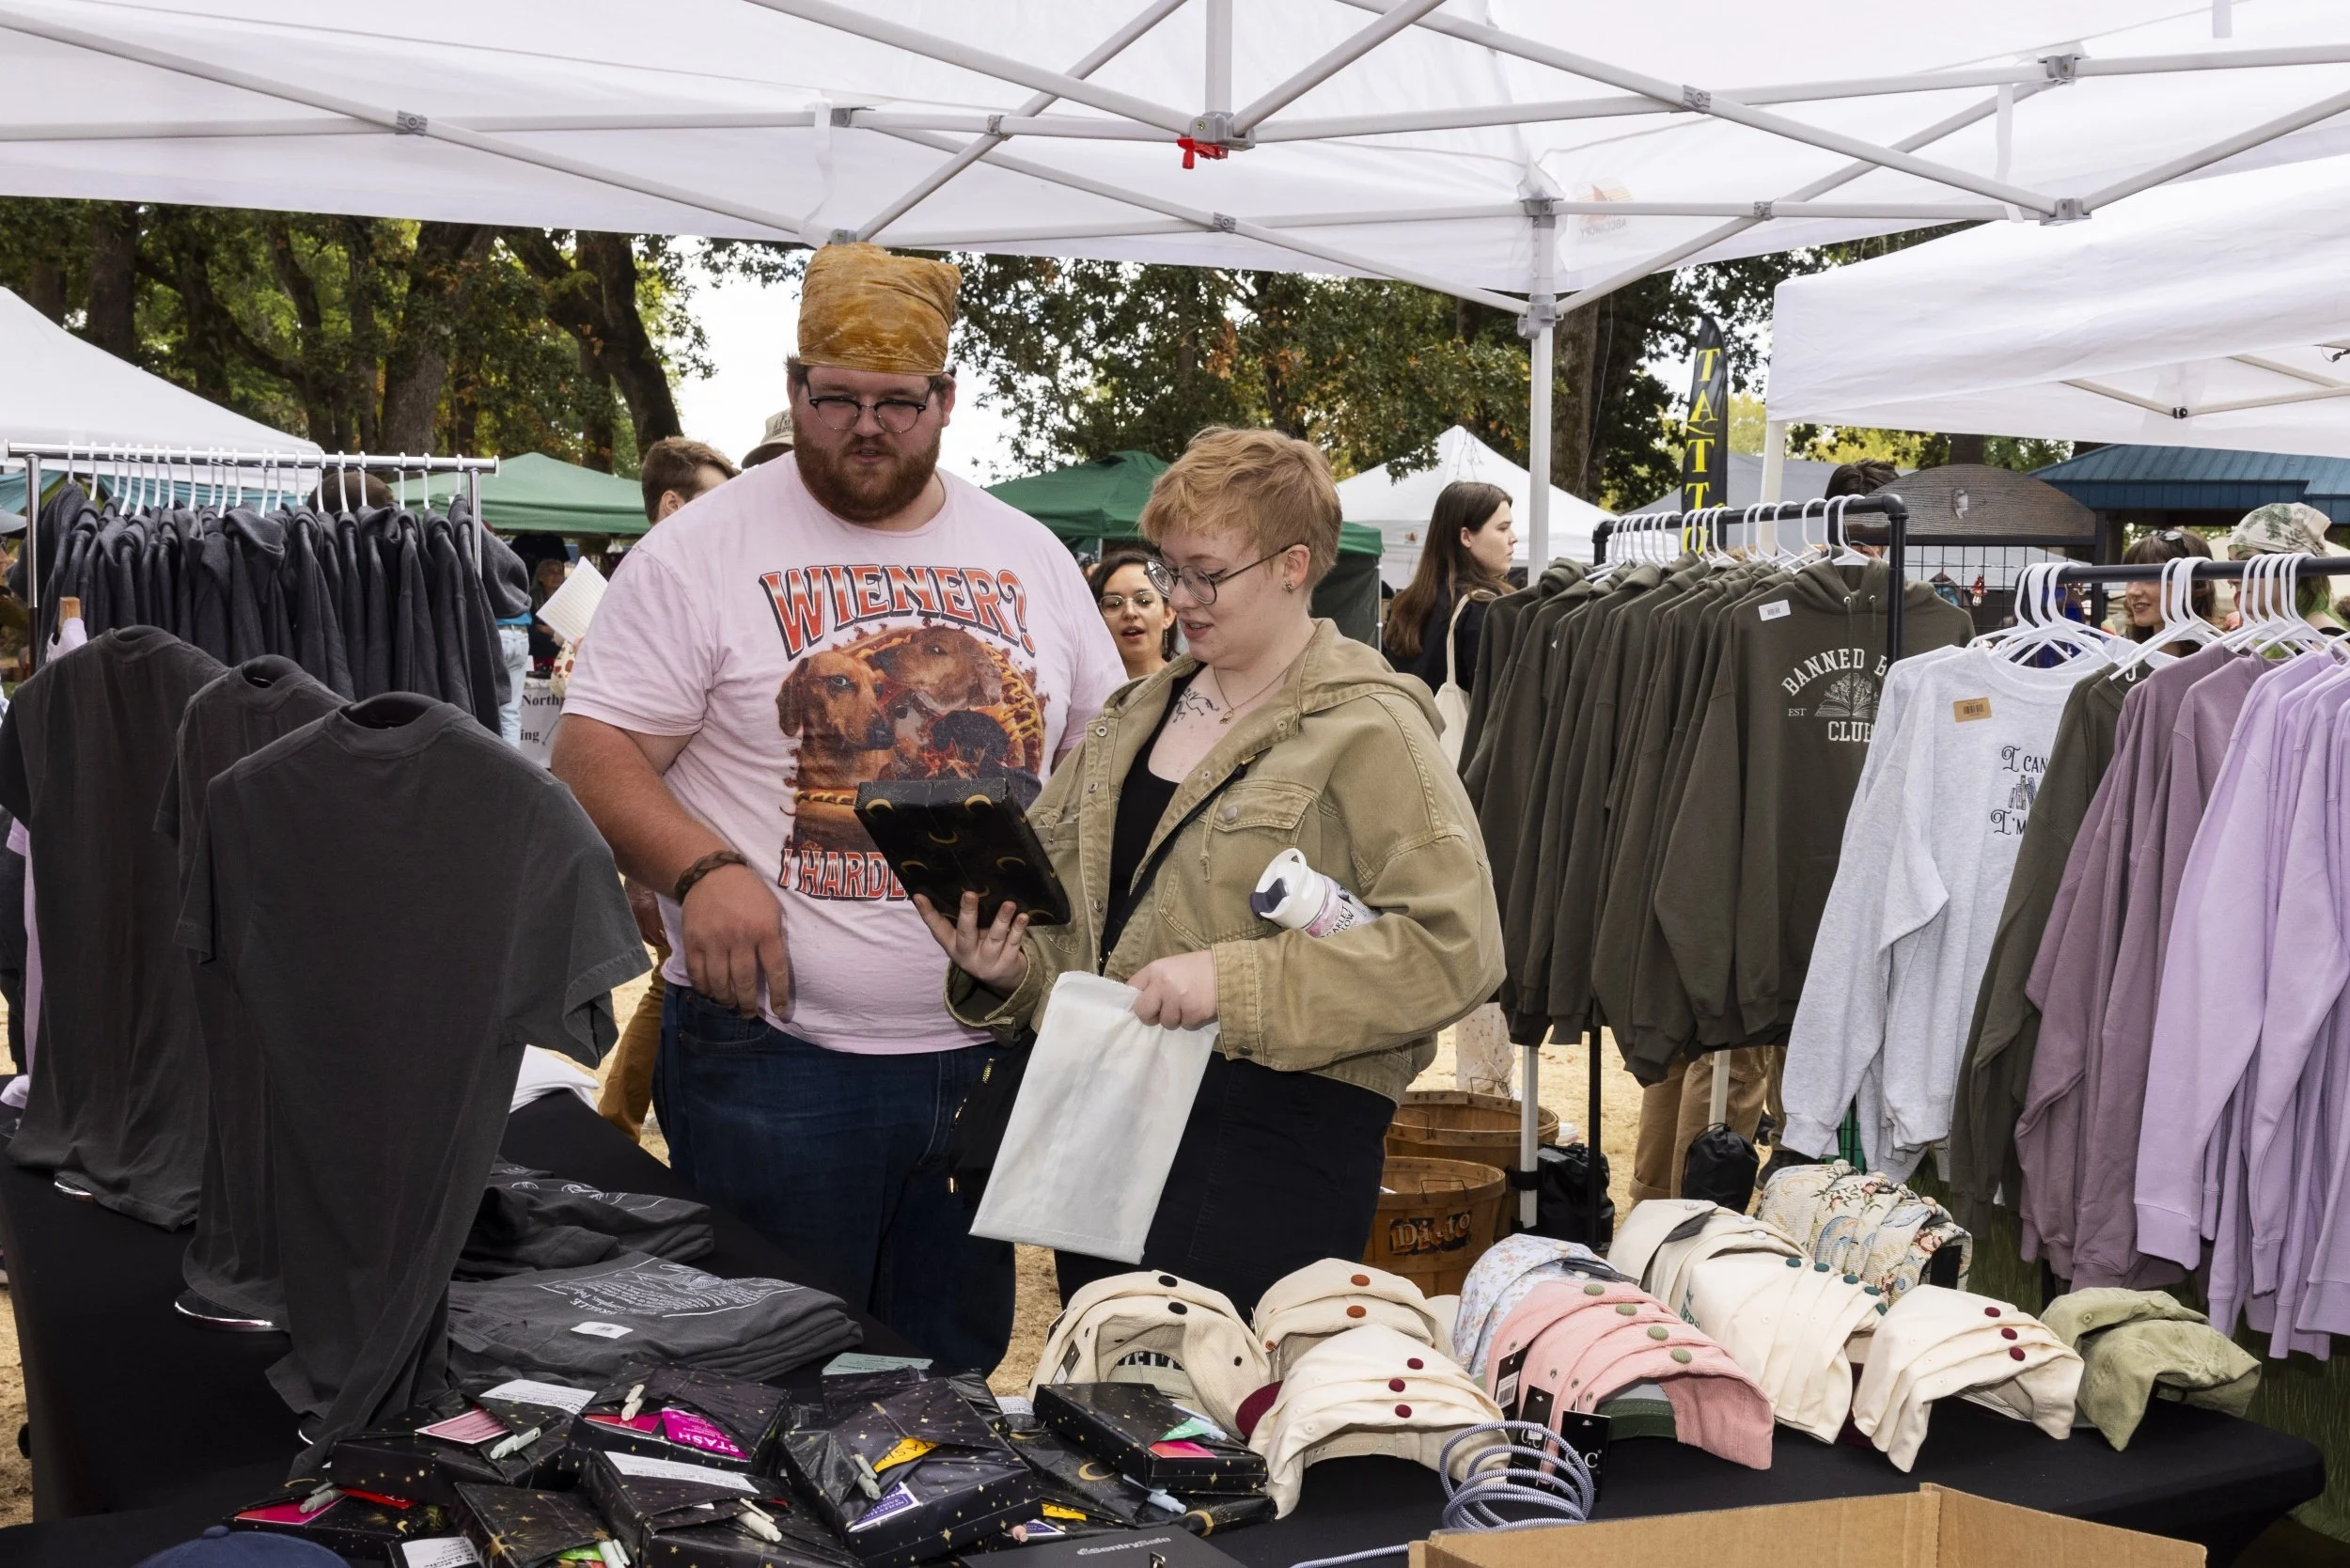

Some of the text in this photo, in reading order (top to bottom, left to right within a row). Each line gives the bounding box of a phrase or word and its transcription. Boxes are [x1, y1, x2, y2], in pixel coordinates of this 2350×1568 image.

[1683, 348, 1721, 556] TATTO
[759, 564, 1035, 661] WIENER?
[1781, 648, 1865, 696] BANNED
[1788, 708, 1807, 716] EST
[2001, 745, 2021, 773] I
[778, 847, 793, 889] I
[678, 1432, 740, 1452] STASH
